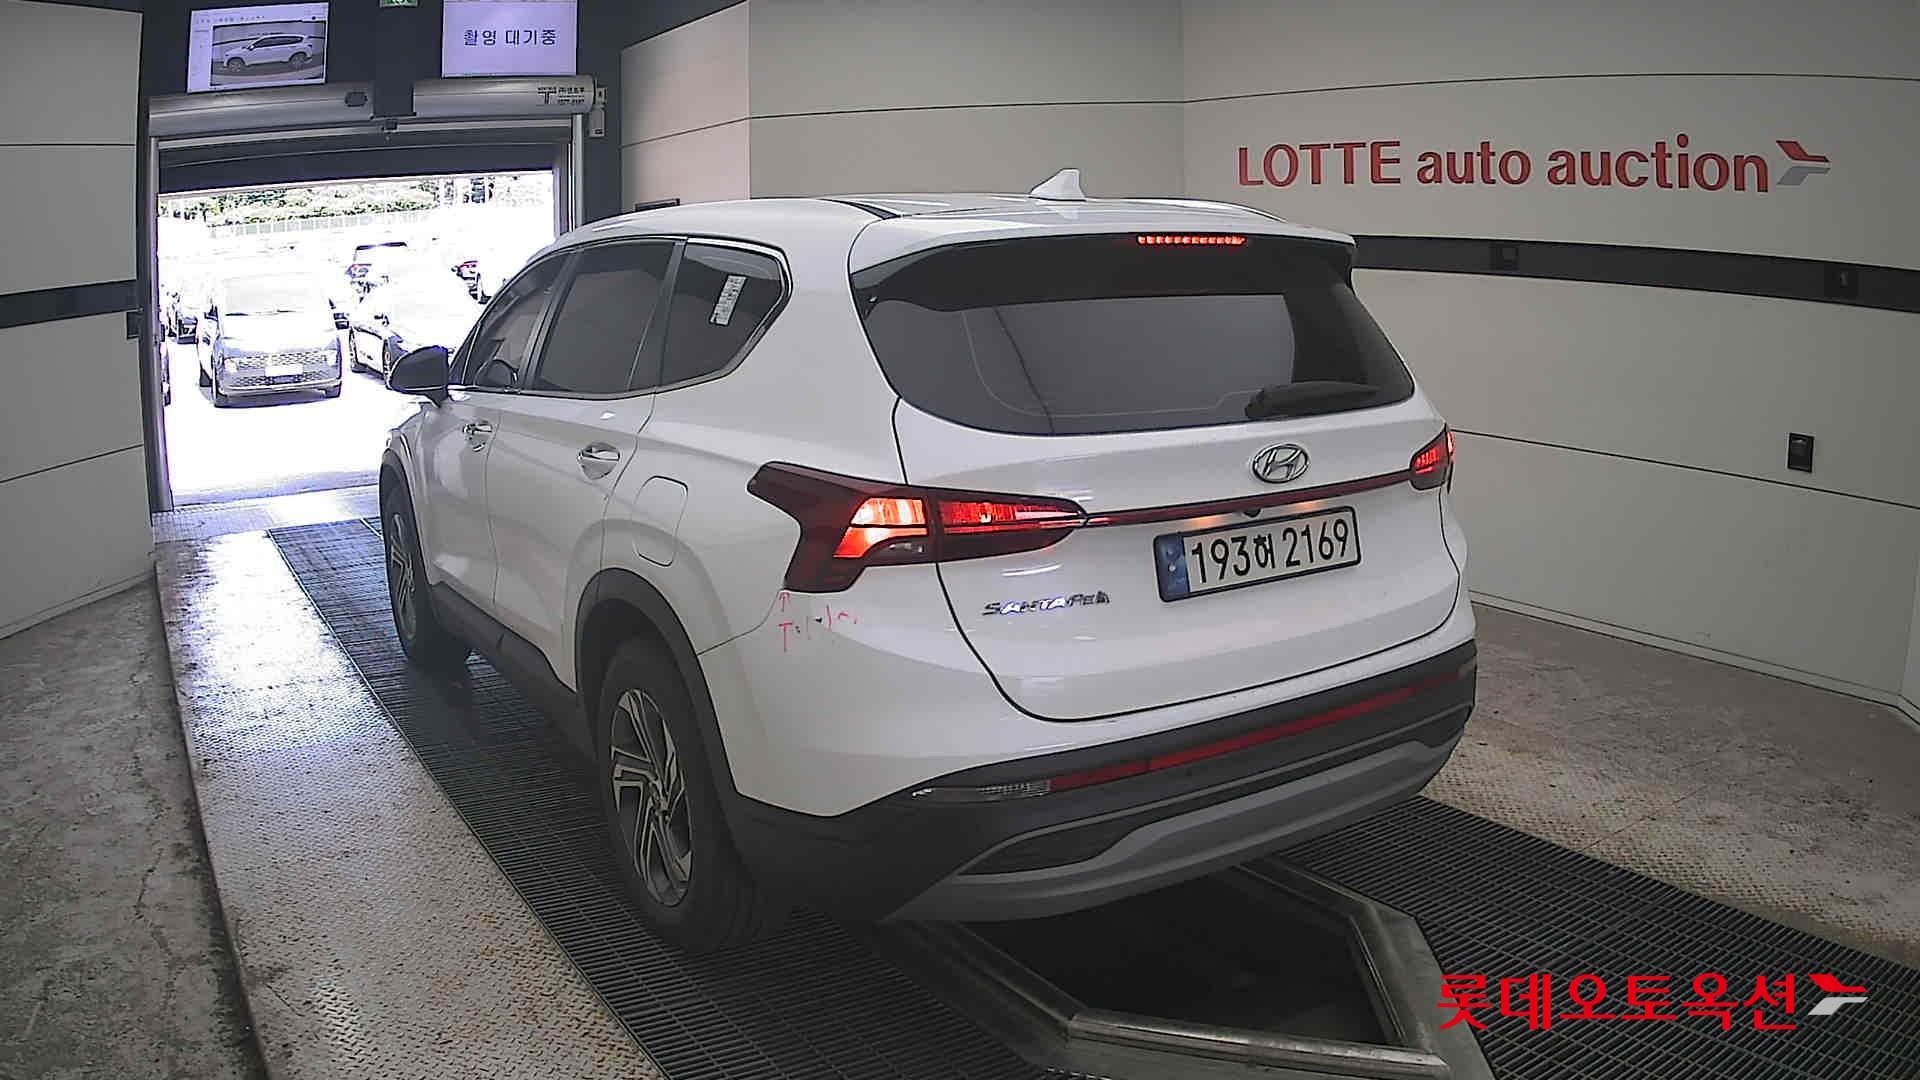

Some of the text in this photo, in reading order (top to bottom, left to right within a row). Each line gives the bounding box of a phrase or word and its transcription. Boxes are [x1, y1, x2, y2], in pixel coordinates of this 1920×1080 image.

[505, 29, 556, 46] 대기중
[1238, 133, 1768, 192] LOTTE auto auction
[1282, 519, 1349, 568] 2169
